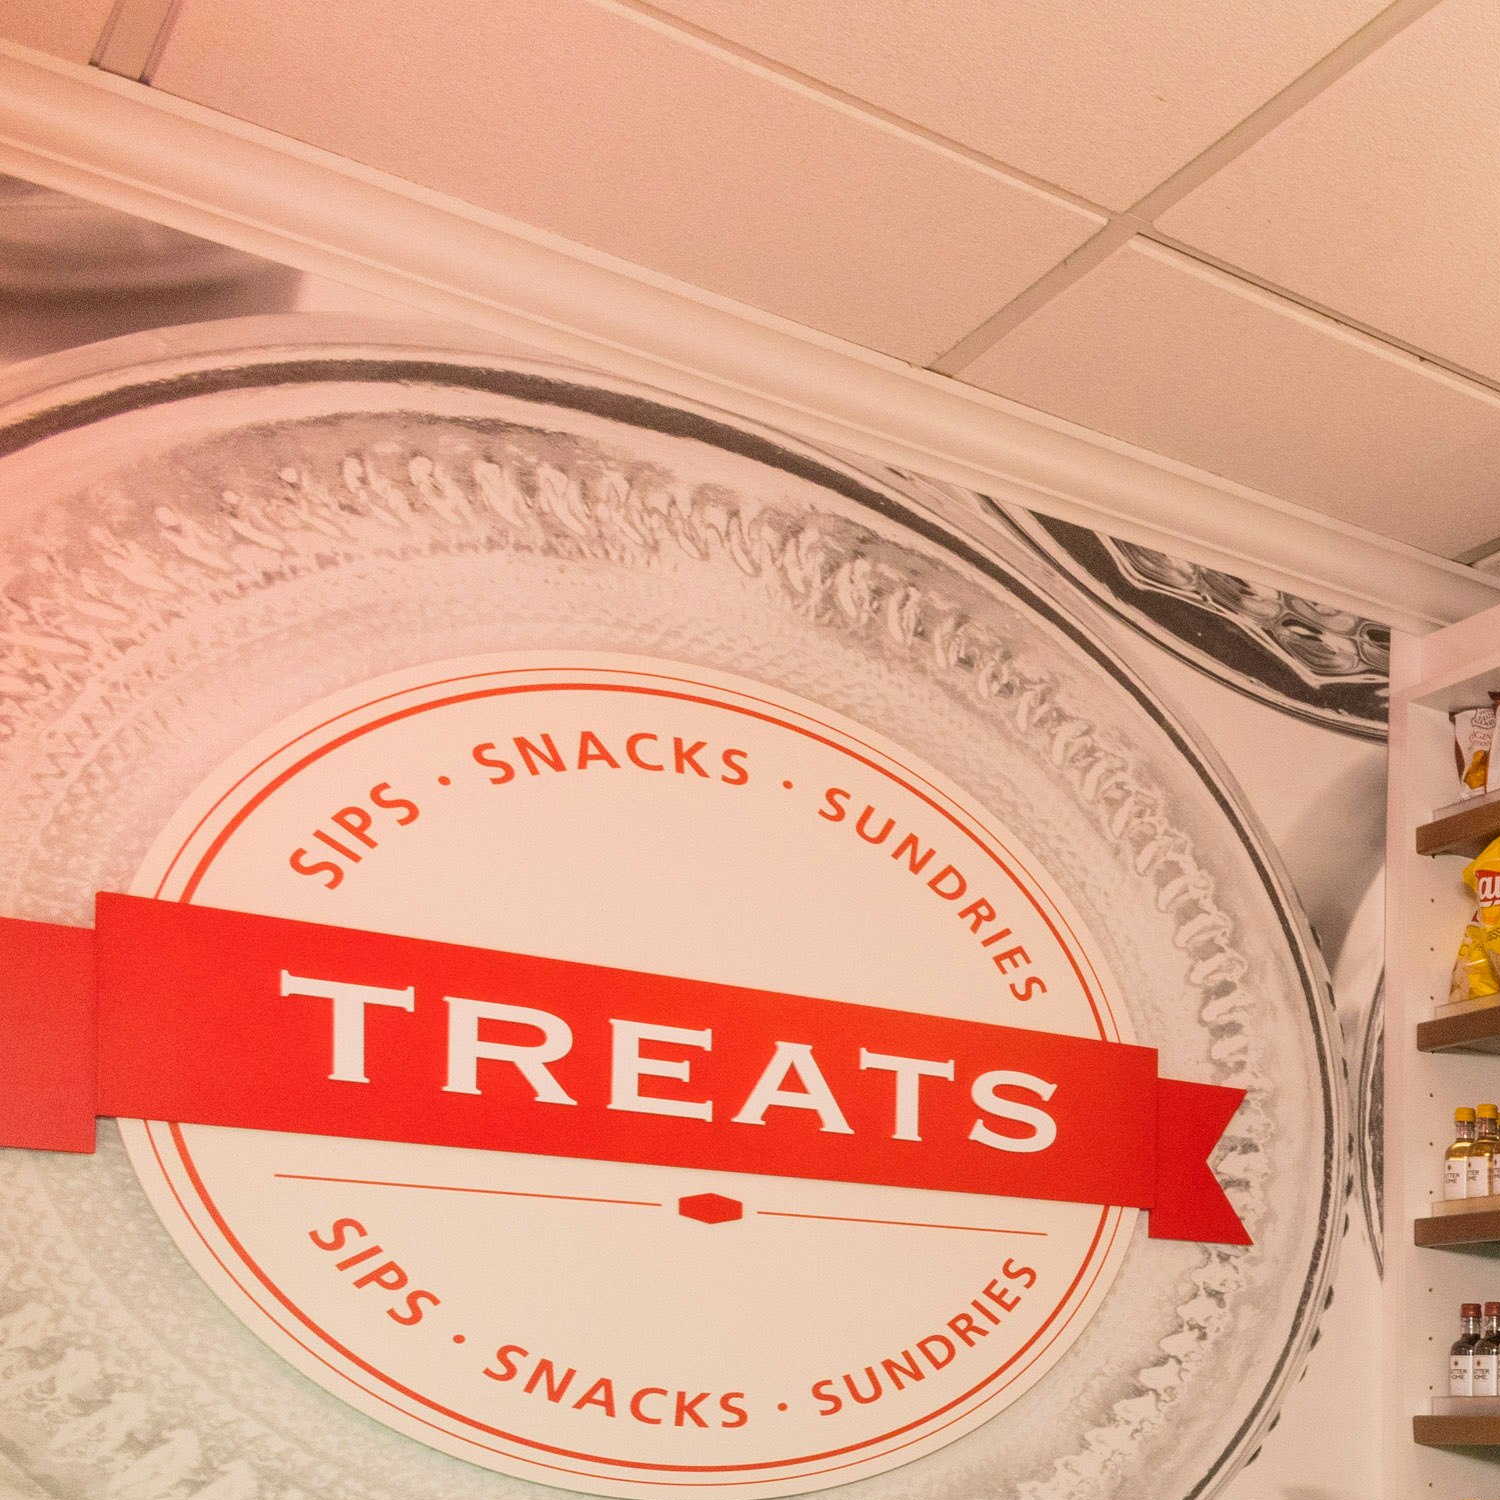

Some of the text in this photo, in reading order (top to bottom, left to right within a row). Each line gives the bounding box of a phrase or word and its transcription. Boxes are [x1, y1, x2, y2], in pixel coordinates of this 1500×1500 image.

[290, 731, 1047, 1003] SIPS SNACKS SUNDRIES
[280, 969, 1058, 1156] TREATS
[310, 1217, 1037, 1429] SIPS SNACKS SUNDRIES
